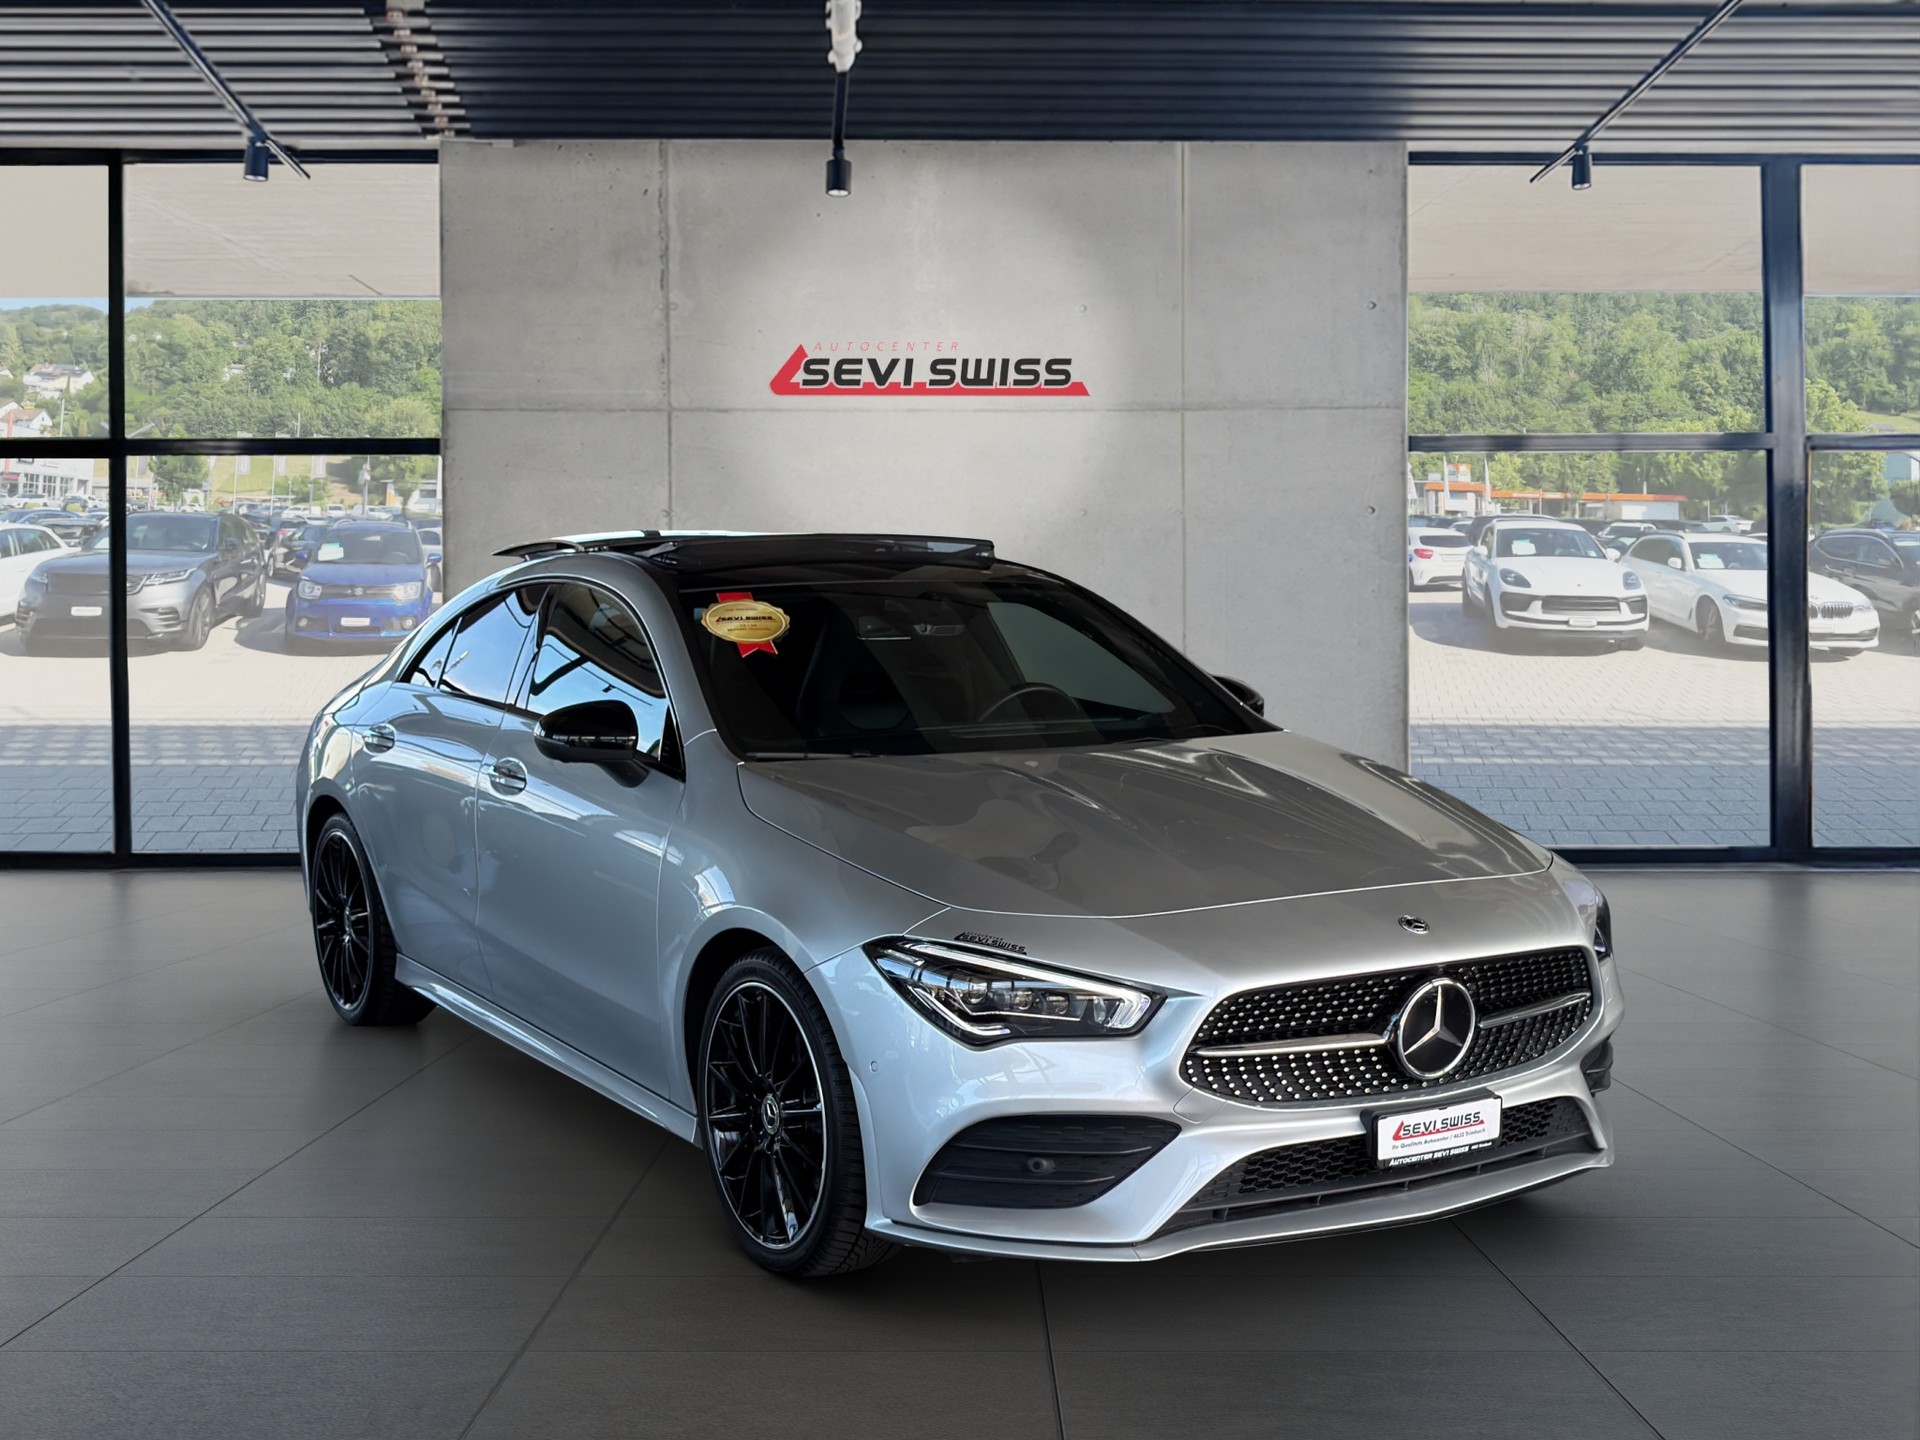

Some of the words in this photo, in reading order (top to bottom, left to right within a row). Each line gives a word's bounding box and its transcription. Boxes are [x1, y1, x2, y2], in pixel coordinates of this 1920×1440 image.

[813, 341, 959, 352] AUTOCENTER
[802, 358, 914, 387] SEVI
[929, 358, 1072, 387] SWISS
[962, 934, 990, 944] SEVI
[990, 939, 1026, 952] SWISS
[1402, 1119, 1437, 1136] SEVI
[1440, 1111, 1481, 1129] SWISS
[1389, 1153, 1433, 1166] AUTOCENTER
[1433, 1150, 1450, 1158] SEVI
